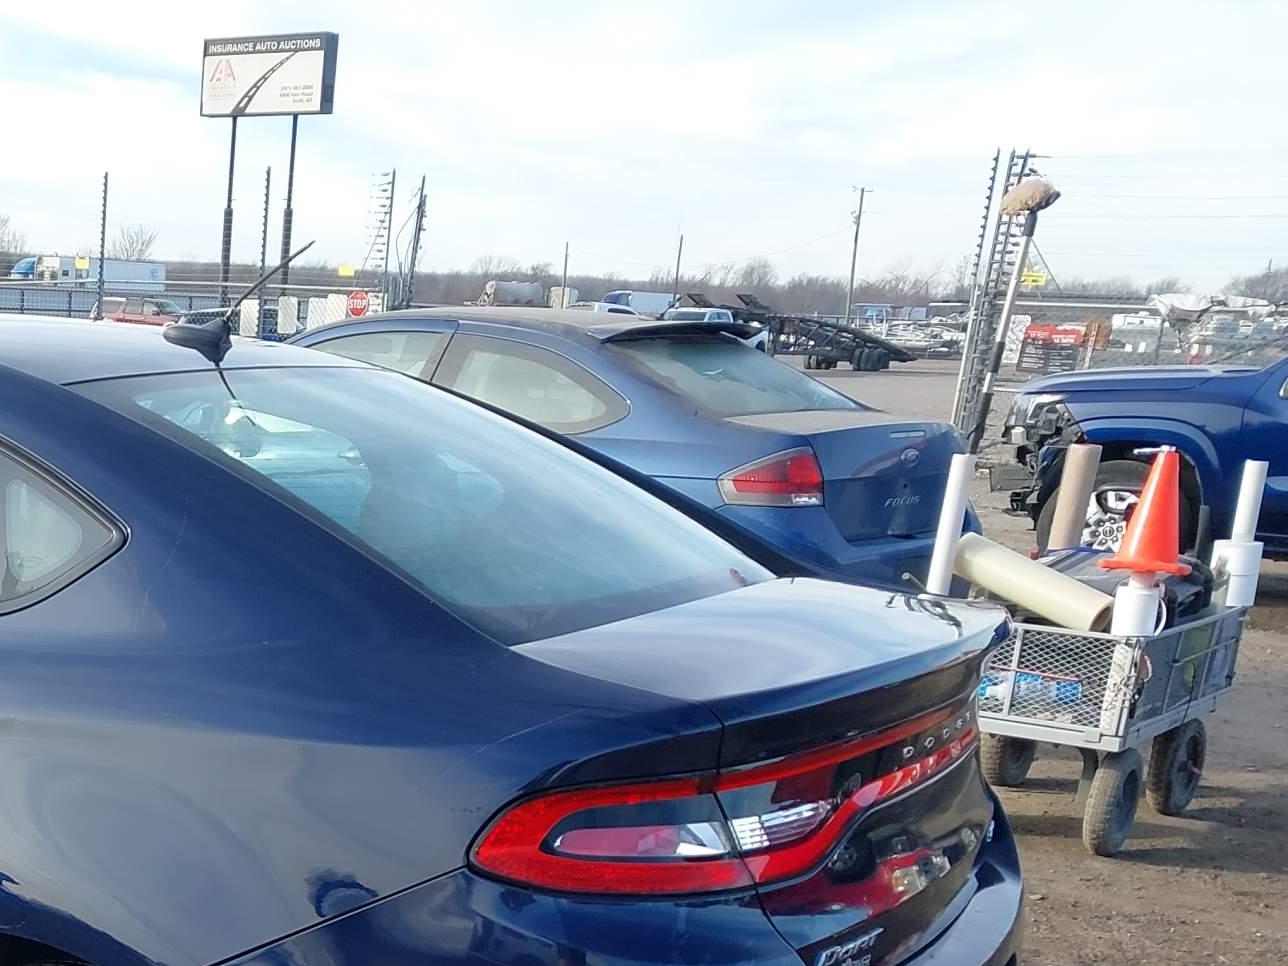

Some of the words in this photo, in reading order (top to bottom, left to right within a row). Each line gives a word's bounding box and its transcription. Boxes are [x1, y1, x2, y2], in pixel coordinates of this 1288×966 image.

[209, 42, 254, 53] INSURANCE
[255, 40, 278, 50] AUTO
[279, 38, 321, 49] AUCTIONS
[349, 298, 367, 309] STOP
[902, 710, 973, 759] DODGE
